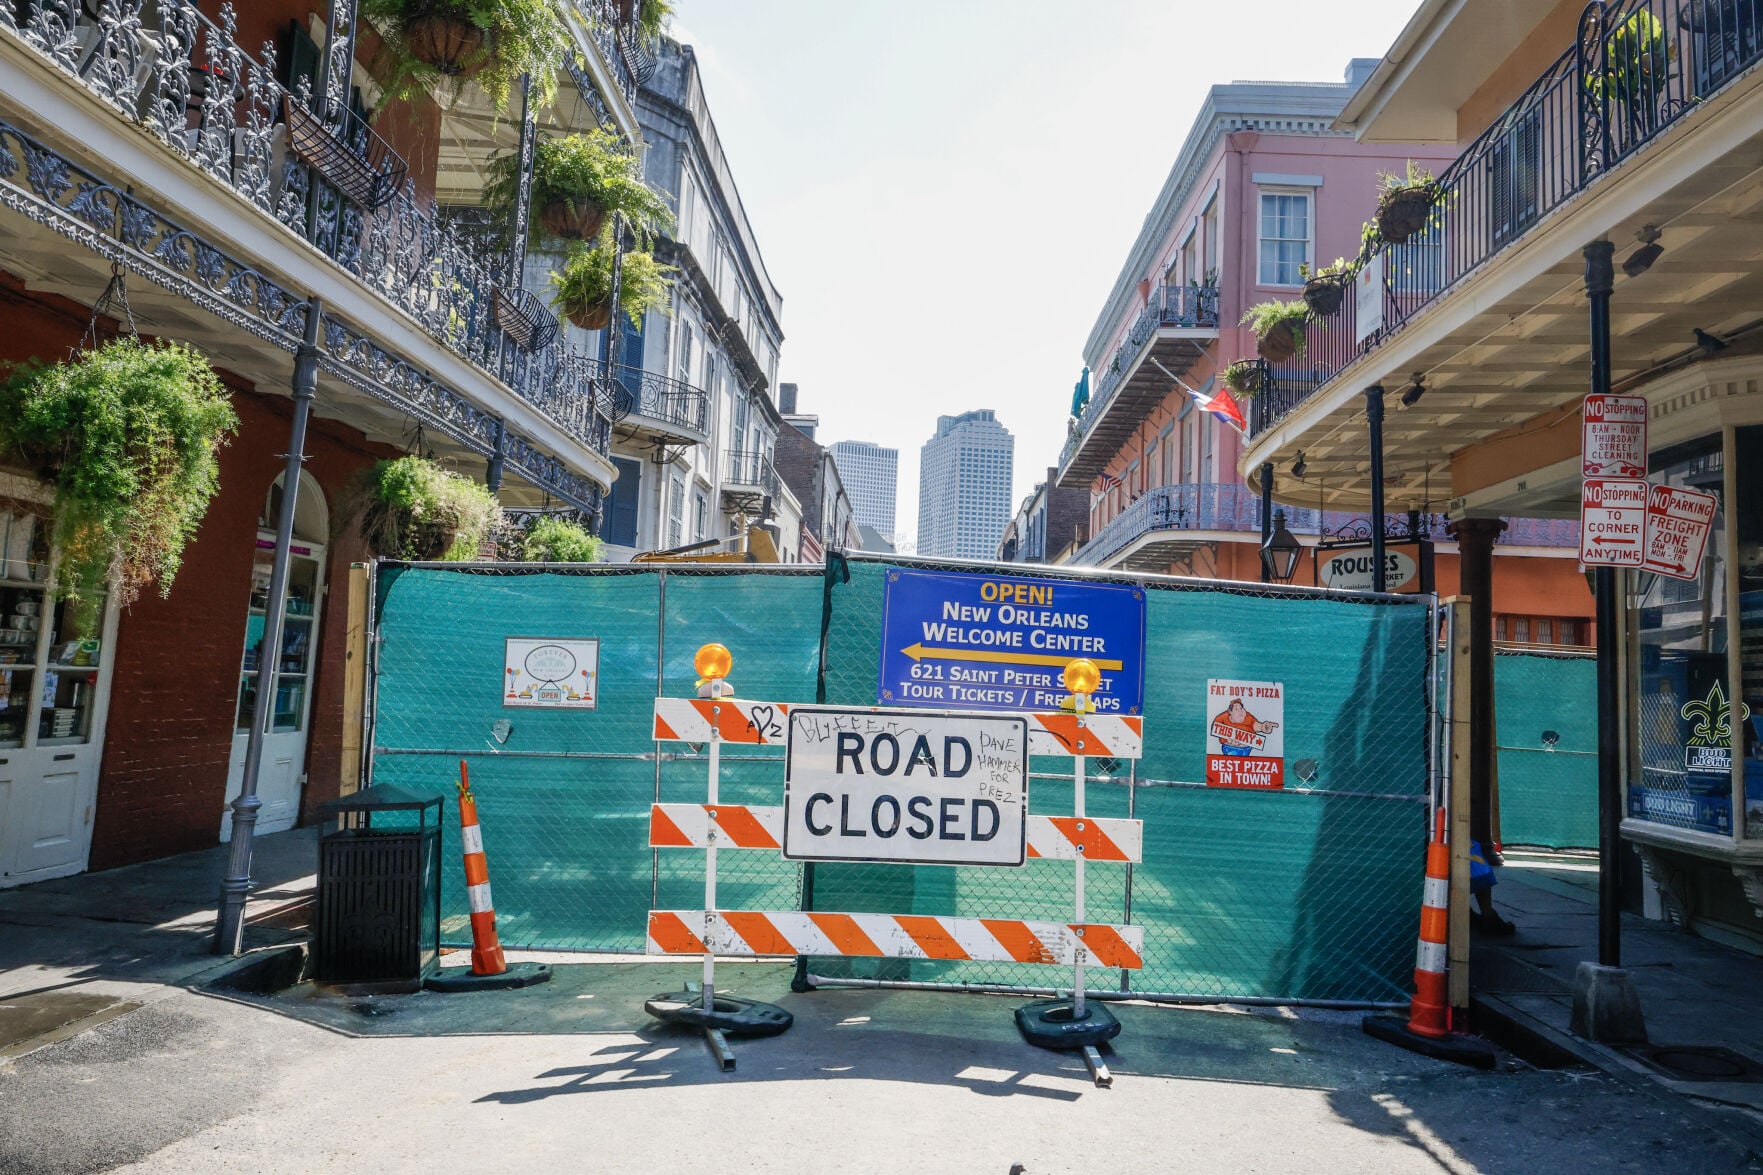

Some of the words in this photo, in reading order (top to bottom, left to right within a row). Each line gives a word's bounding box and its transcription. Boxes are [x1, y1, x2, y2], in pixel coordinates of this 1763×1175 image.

[1586, 401, 1604, 417] NO
[1604, 404, 1645, 415] STOPPING
[1620, 424, 1640, 434] NOON
[1594, 434, 1638, 444] THURSDAY
[1598, 443, 1632, 452] STREET
[1592, 452, 1639, 460] CLEANING
[1584, 486, 1602, 502] NO
[1603, 489, 1645, 502] STOPPING
[1650, 491, 1670, 509] NO
[1669, 498, 1712, 516] PARKING
[1606, 510, 1622, 521] TO
[1588, 522, 1639, 534] CORNER
[1650, 516, 1703, 537] FREIGHT
[1654, 530, 1690, 548] ZONE
[1585, 548, 1640, 560] ANYTIME
[1650, 548, 1666, 558] MON
[1674, 554, 1685, 562] FRI
[1372, 573, 1404, 582] RKET
[980, 582, 1053, 605] OPEN!
[942, 601, 991, 623] NEW
[998, 605, 1089, 630] ORLEANS
[922, 622, 1024, 646] WELCOME
[1030, 629, 1106, 653] CENTER
[910, 664, 944, 680] 621
[950, 666, 999, 684] SAINT
[1004, 669, 1052, 688] PETER
[1056, 673, 1113, 691] SET
[542, 691, 559, 700] OPEN
[900, 682, 944, 700] TOUR
[949, 685, 1014, 704] TICKETS
[1034, 690, 1066, 706] FRE
[1088, 694, 1120, 710] APS
[1210, 685, 1226, 696] FAT
[1230, 686, 1254, 697] BOY'S
[1256, 687, 1280, 699] PIZZA
[980, 730, 1017, 753] DAVE
[1214, 724, 1233, 738] THIS
[1234, 730, 1257, 745] WAY
[836, 732, 973, 778] ROAD
[1698, 748, 1726, 758] BUD
[977, 755, 1022, 774] HAMMER
[1212, 760, 1241, 772] BEST
[1244, 761, 1279, 774] PIZZA
[1692, 756, 1731, 766] LIGHT
[990, 771, 1010, 784] FOR
[1220, 772, 1232, 784] IN
[1236, 772, 1272, 786] TOWN!
[980, 782, 1016, 803] PREZ
[804, 792, 1001, 842] CLOSED
